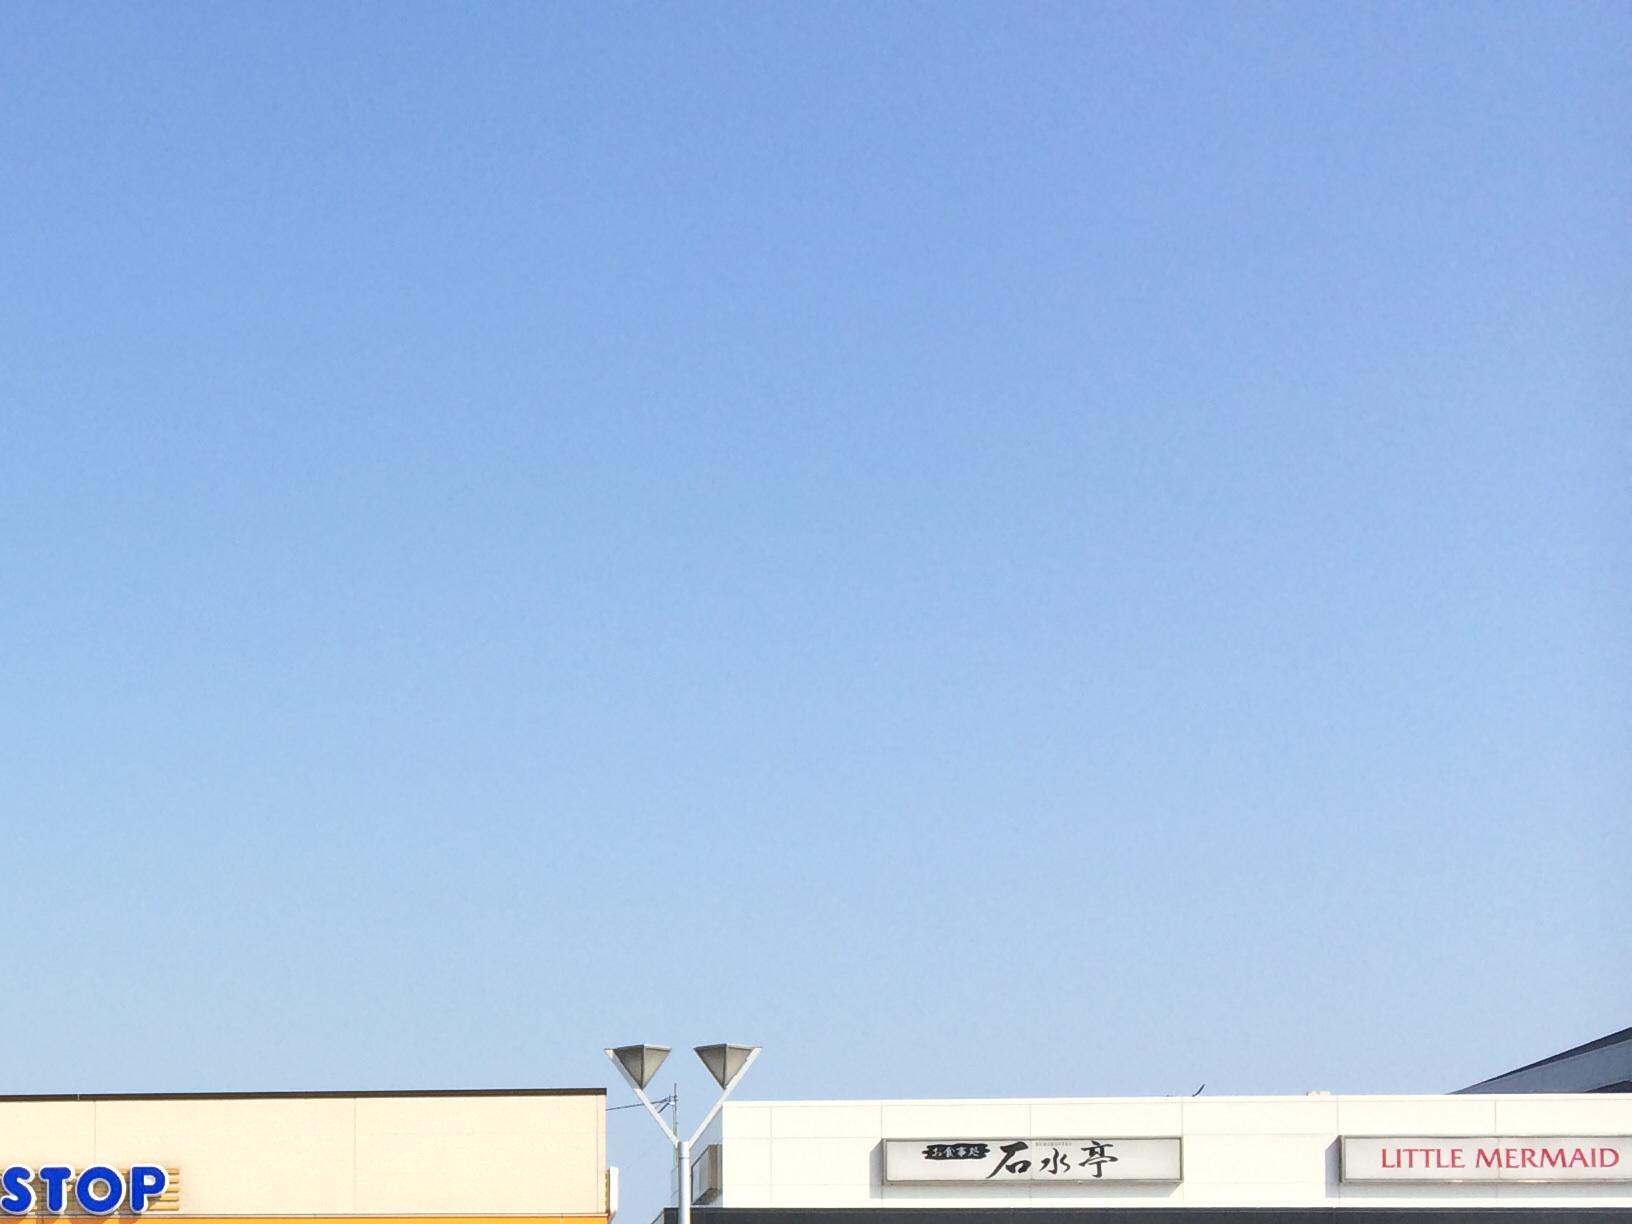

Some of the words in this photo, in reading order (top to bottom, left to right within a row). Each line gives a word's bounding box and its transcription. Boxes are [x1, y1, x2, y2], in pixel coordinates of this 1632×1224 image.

[930, 1146, 983, 1159] お食事処
[986, 1141, 1119, 1179] 石水亭
[1381, 1148, 1465, 1168] LITTLE
[1475, 1148, 1620, 1168] MERMAID
